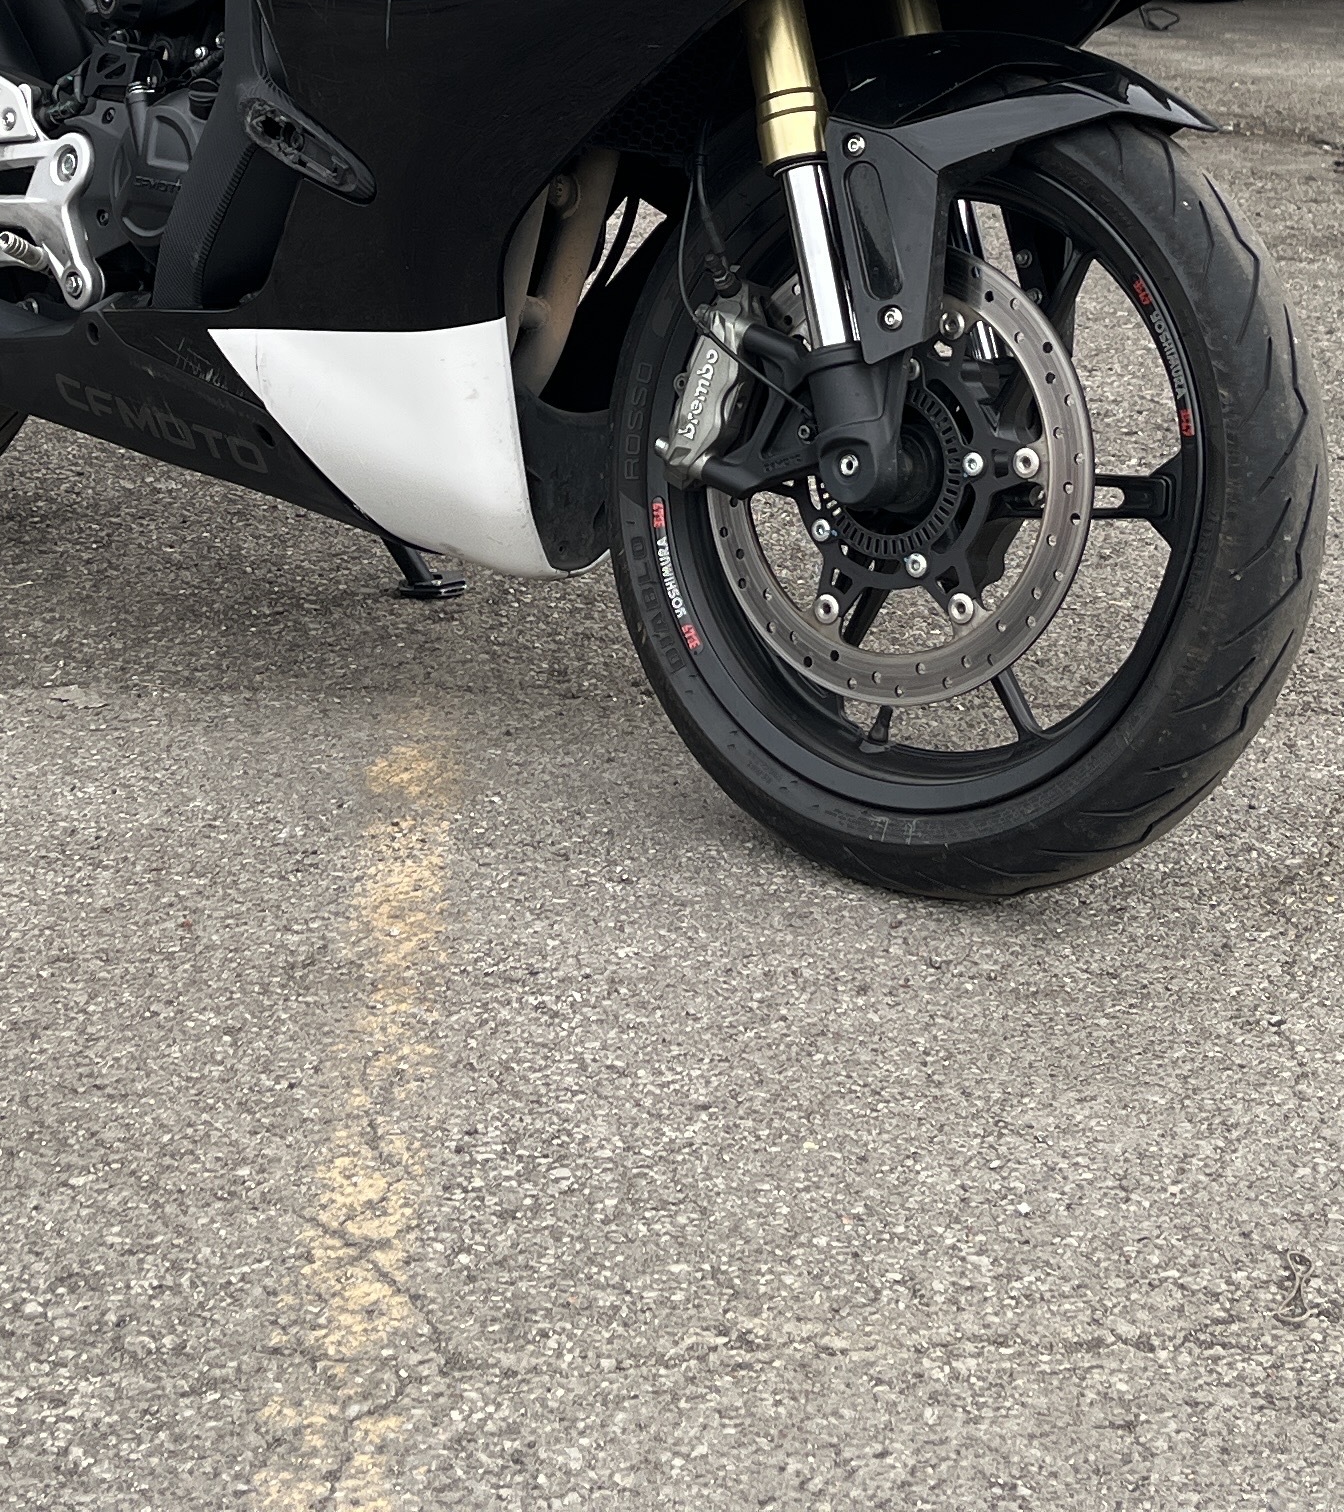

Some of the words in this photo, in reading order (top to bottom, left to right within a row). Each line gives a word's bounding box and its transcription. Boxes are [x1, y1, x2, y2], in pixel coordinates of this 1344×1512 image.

[677, 349, 719, 440] brembo
[1150, 311, 1187, 400] YOSHIMURA
[56, 372, 269, 473] CFMOTO
[624, 362, 653, 480] ROSSO
[631, 536, 687, 675] DIABLO
[656, 535, 687, 619] YOSHIMURA
